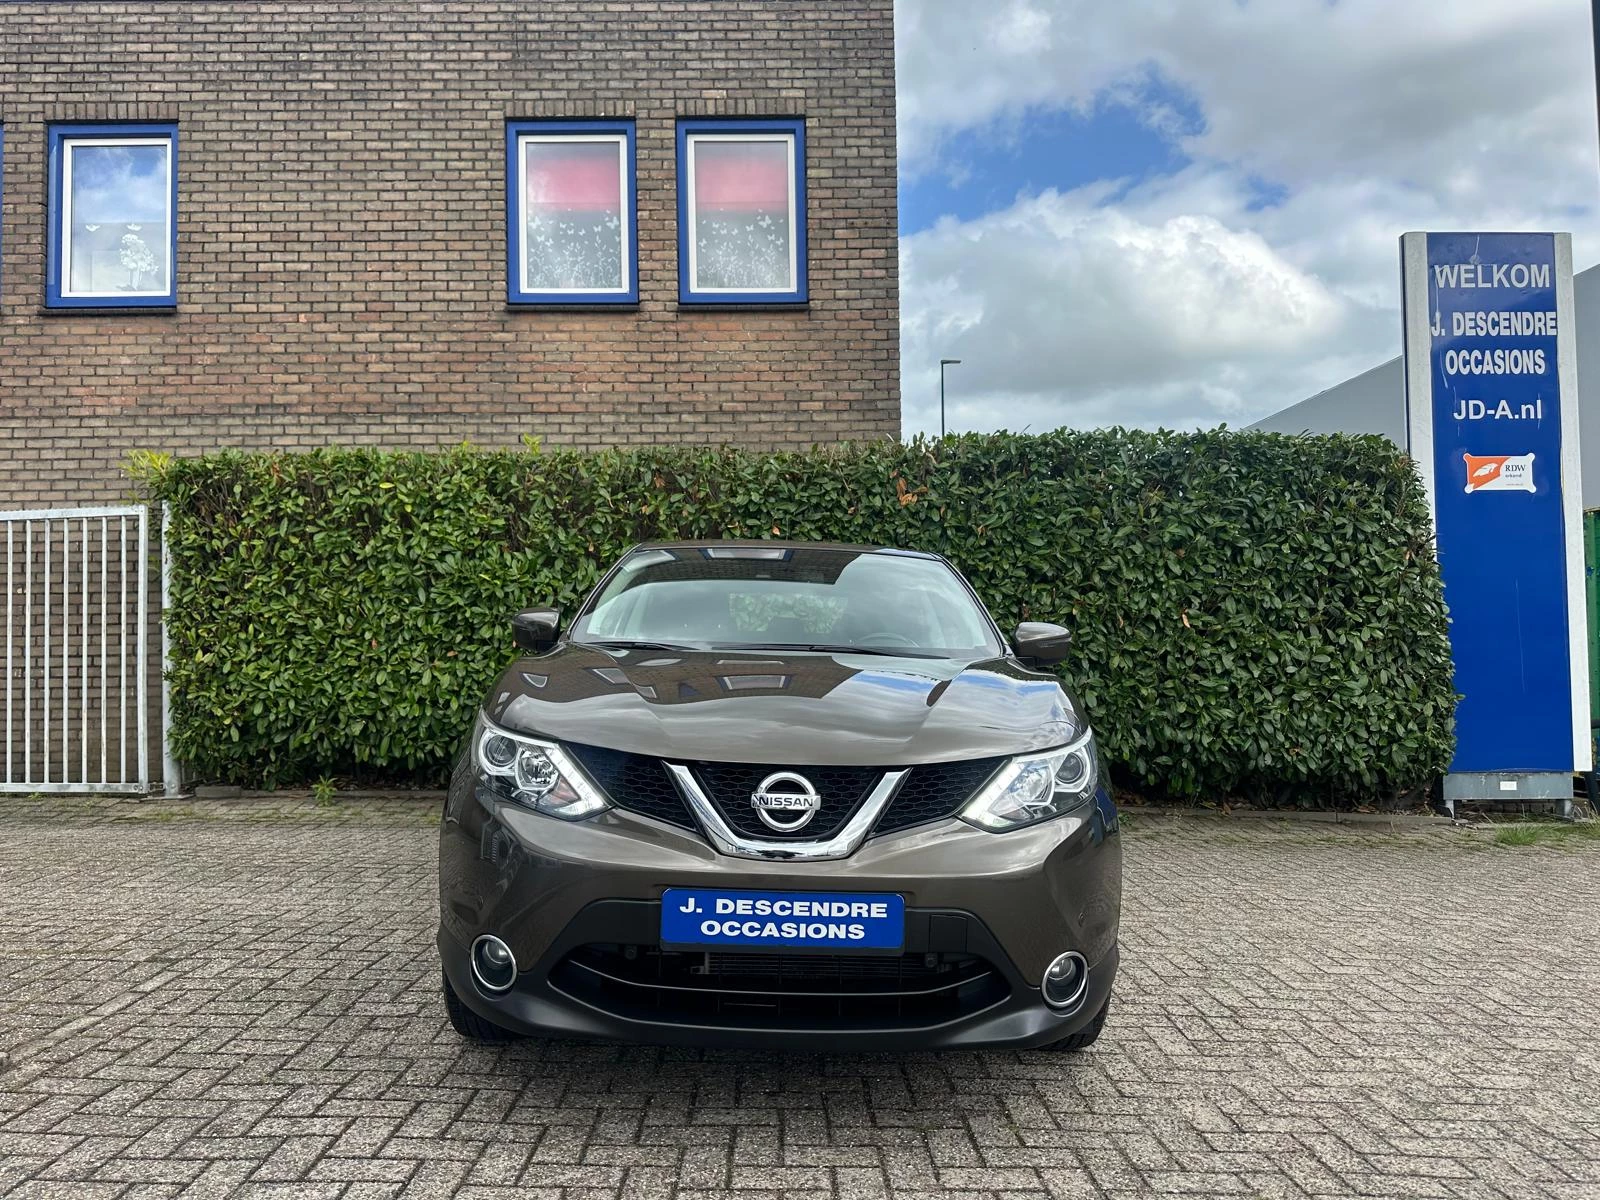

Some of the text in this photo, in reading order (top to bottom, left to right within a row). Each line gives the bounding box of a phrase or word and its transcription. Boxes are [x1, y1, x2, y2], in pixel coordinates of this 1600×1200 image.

[1434, 263, 1551, 289] WELKOM
[1431, 311, 1558, 337] J. DESCENDRE
[1445, 349, 1546, 376] OCCASIONS
[1453, 399, 1543, 421] JD-A.nl
[758, 796, 813, 807] NISSAN
[679, 897, 888, 918] J. DESCENDRE
[700, 920, 866, 940] OCCASIONS
